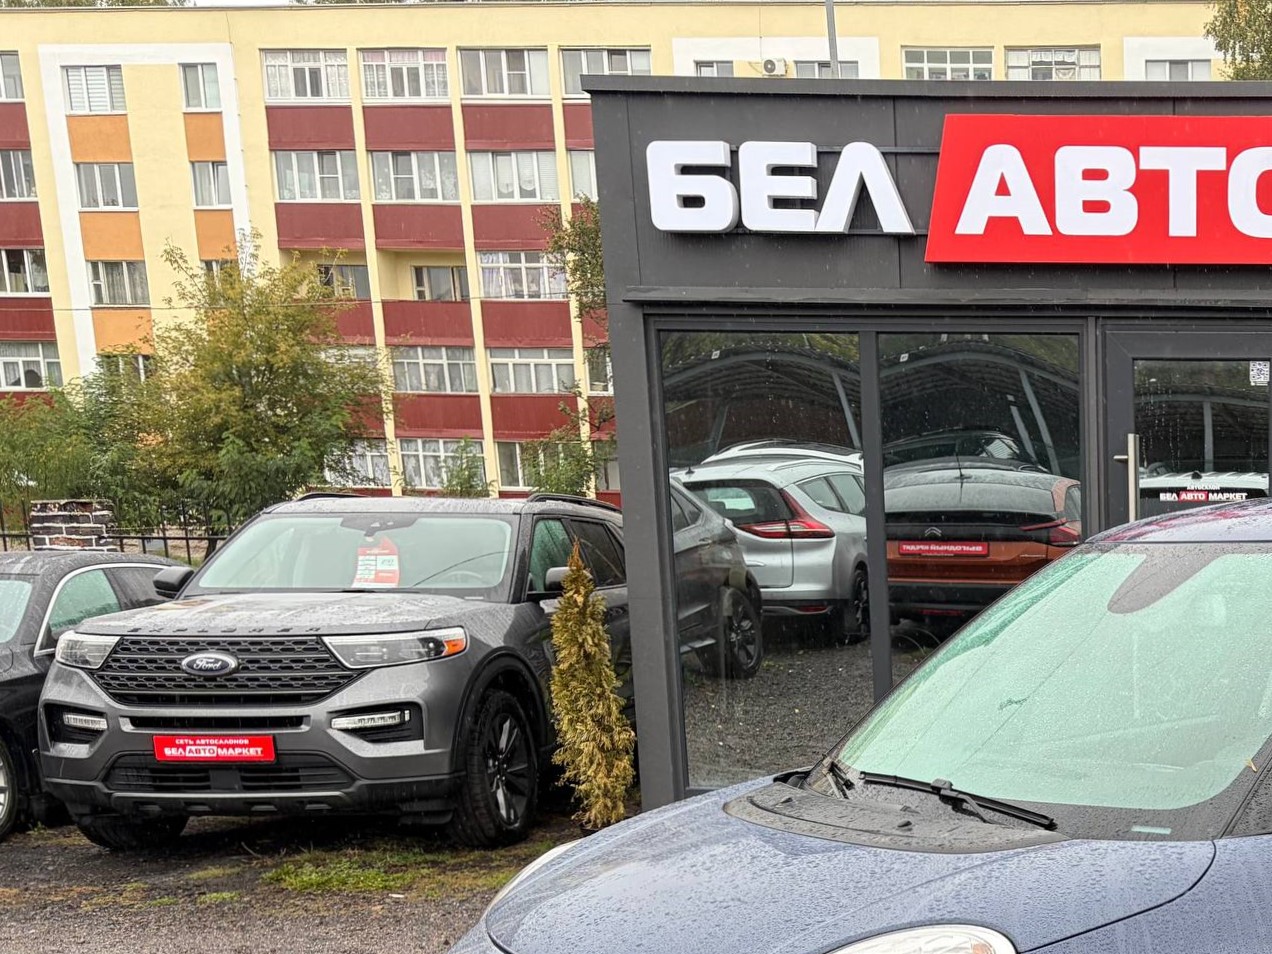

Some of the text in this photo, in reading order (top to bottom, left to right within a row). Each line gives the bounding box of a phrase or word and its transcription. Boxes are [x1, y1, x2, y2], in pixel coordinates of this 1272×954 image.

[646, 140, 915, 235] БЕЛ
[1160, 492, 1178, 500] БЕЛ
[1208, 492, 1248, 500] МАРКЕТ
[193, 658, 221, 670] Ford
[164, 747, 264, 757] БЕЛ АВТО МАРКЕТ
